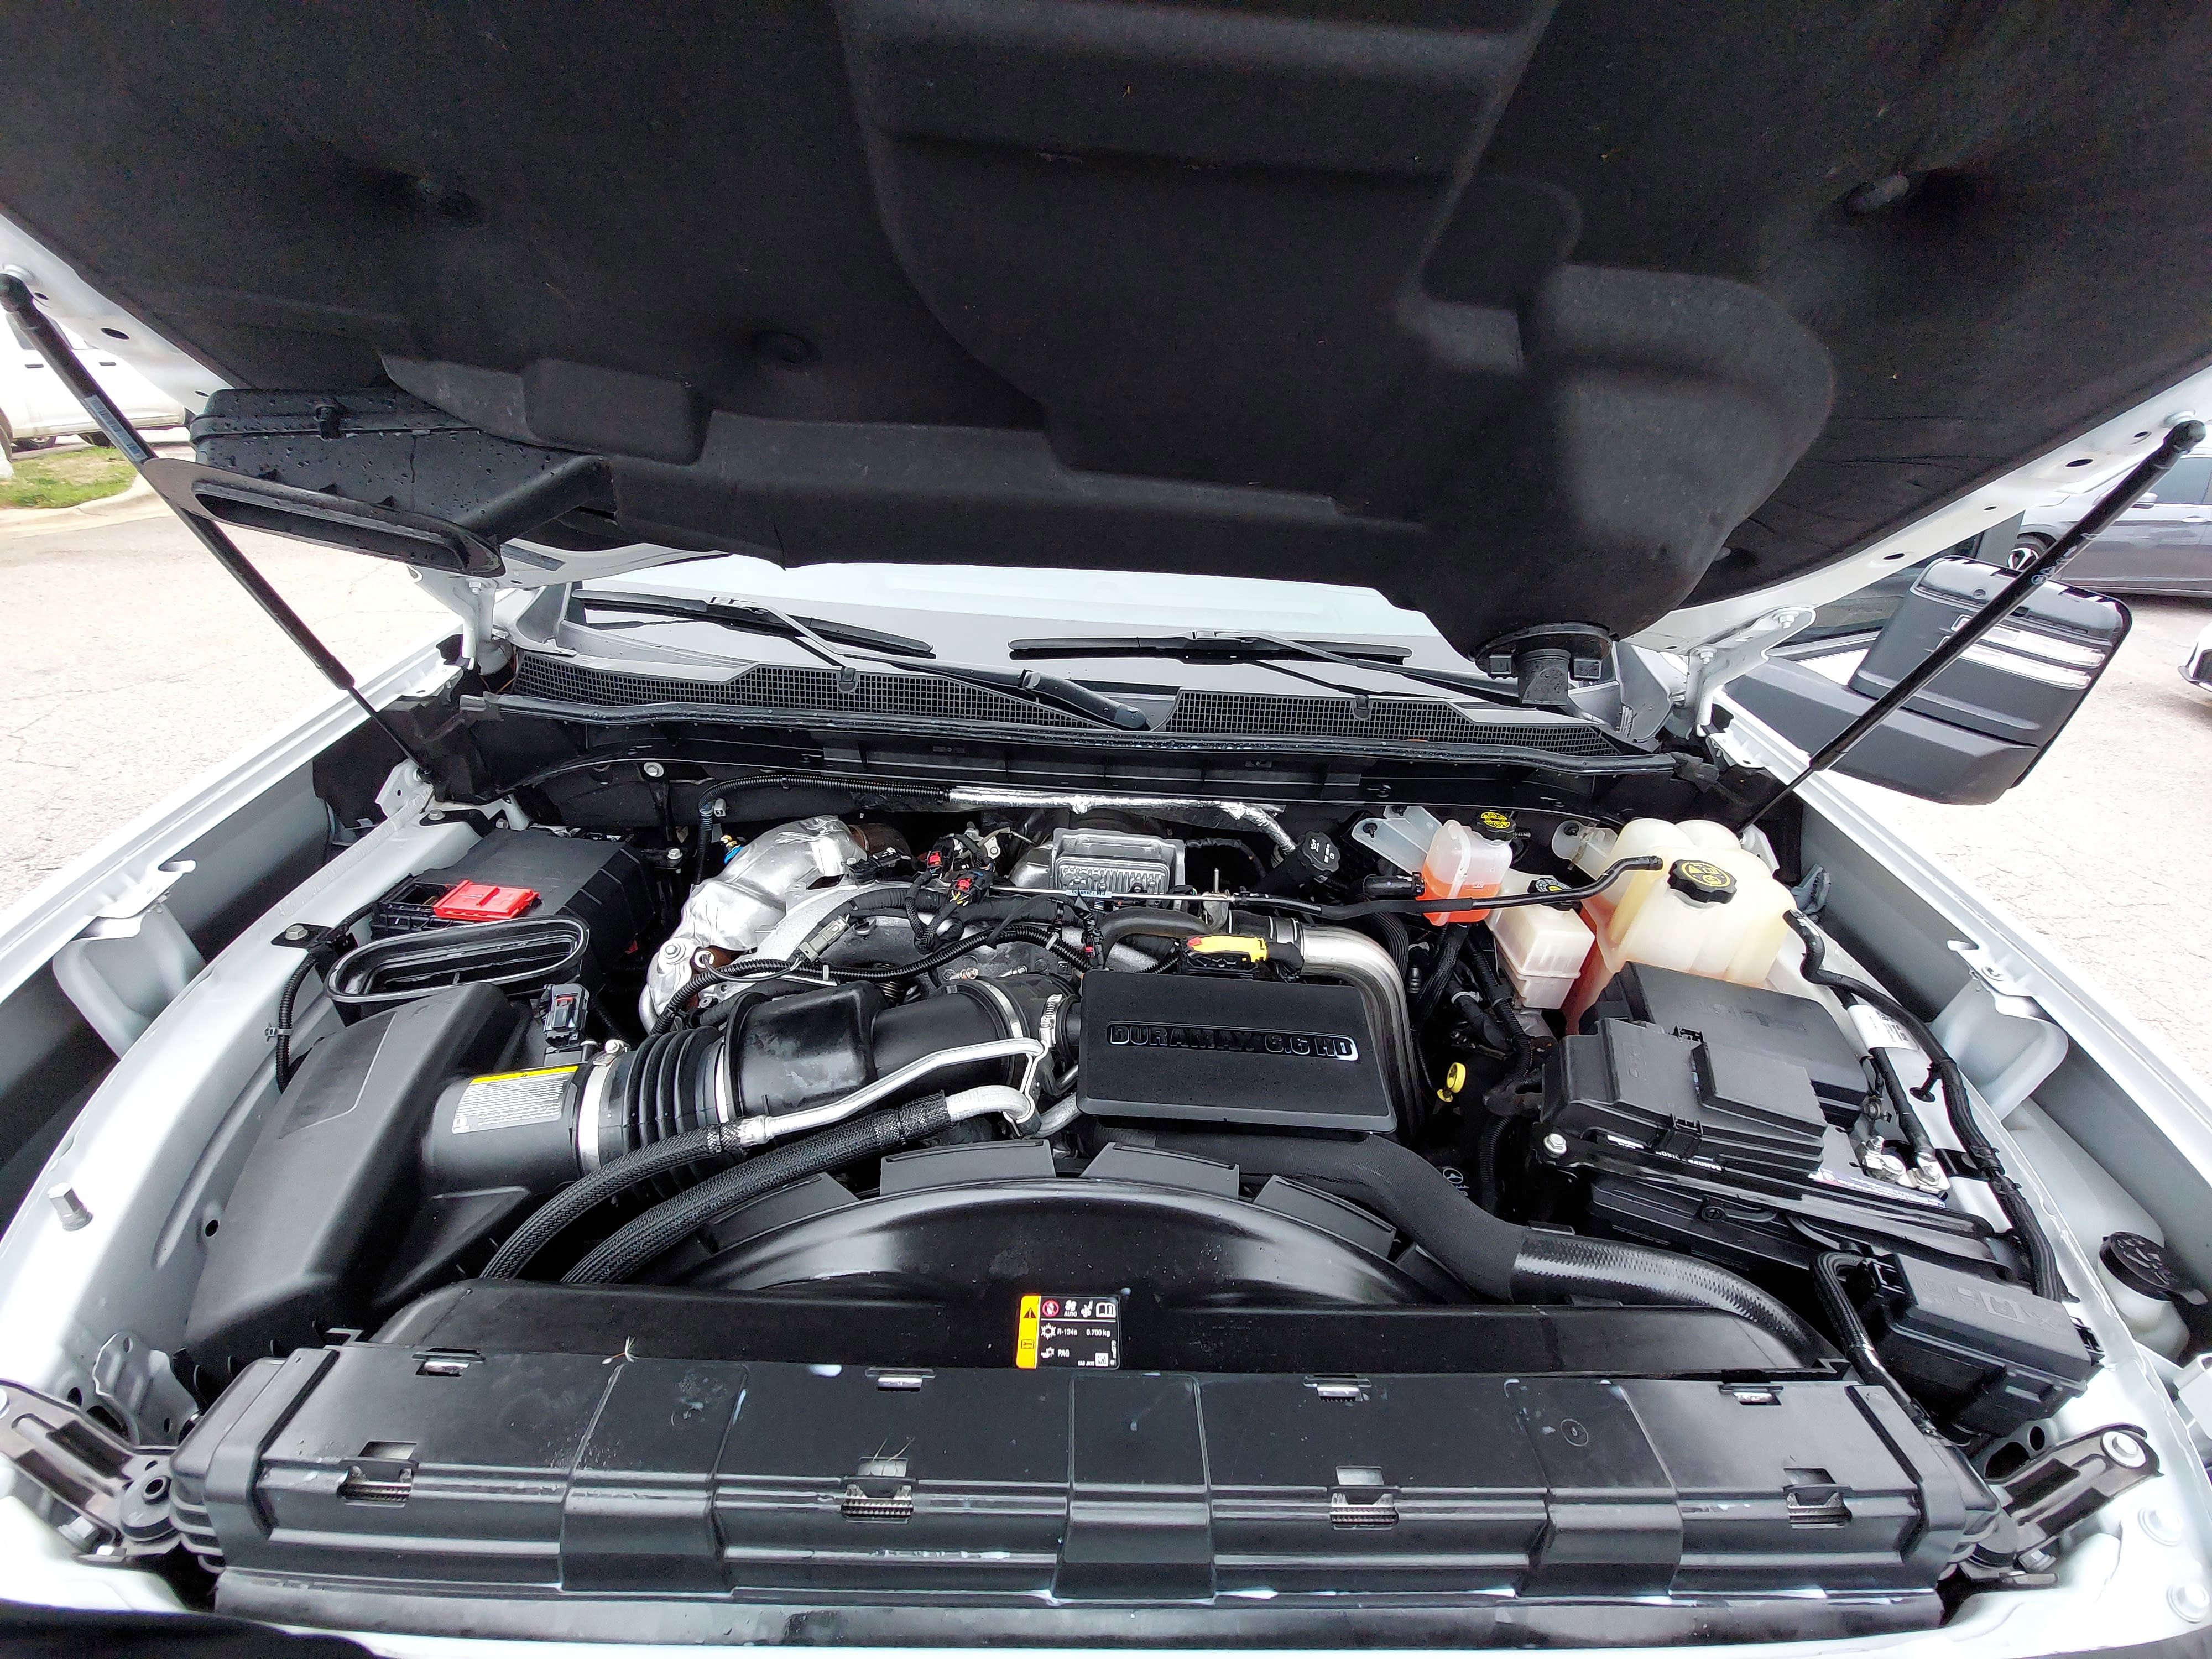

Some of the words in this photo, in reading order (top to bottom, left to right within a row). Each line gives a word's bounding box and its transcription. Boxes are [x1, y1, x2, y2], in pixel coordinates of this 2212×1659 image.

[1110, 1026, 1254, 1051] DURAMAX
[1265, 1034, 1310, 1055] 6.6
[1316, 1036, 1353, 1059] HD
[1086, 1328, 1102, 1337] 0.700
[1103, 1329, 1110, 1337] kg
